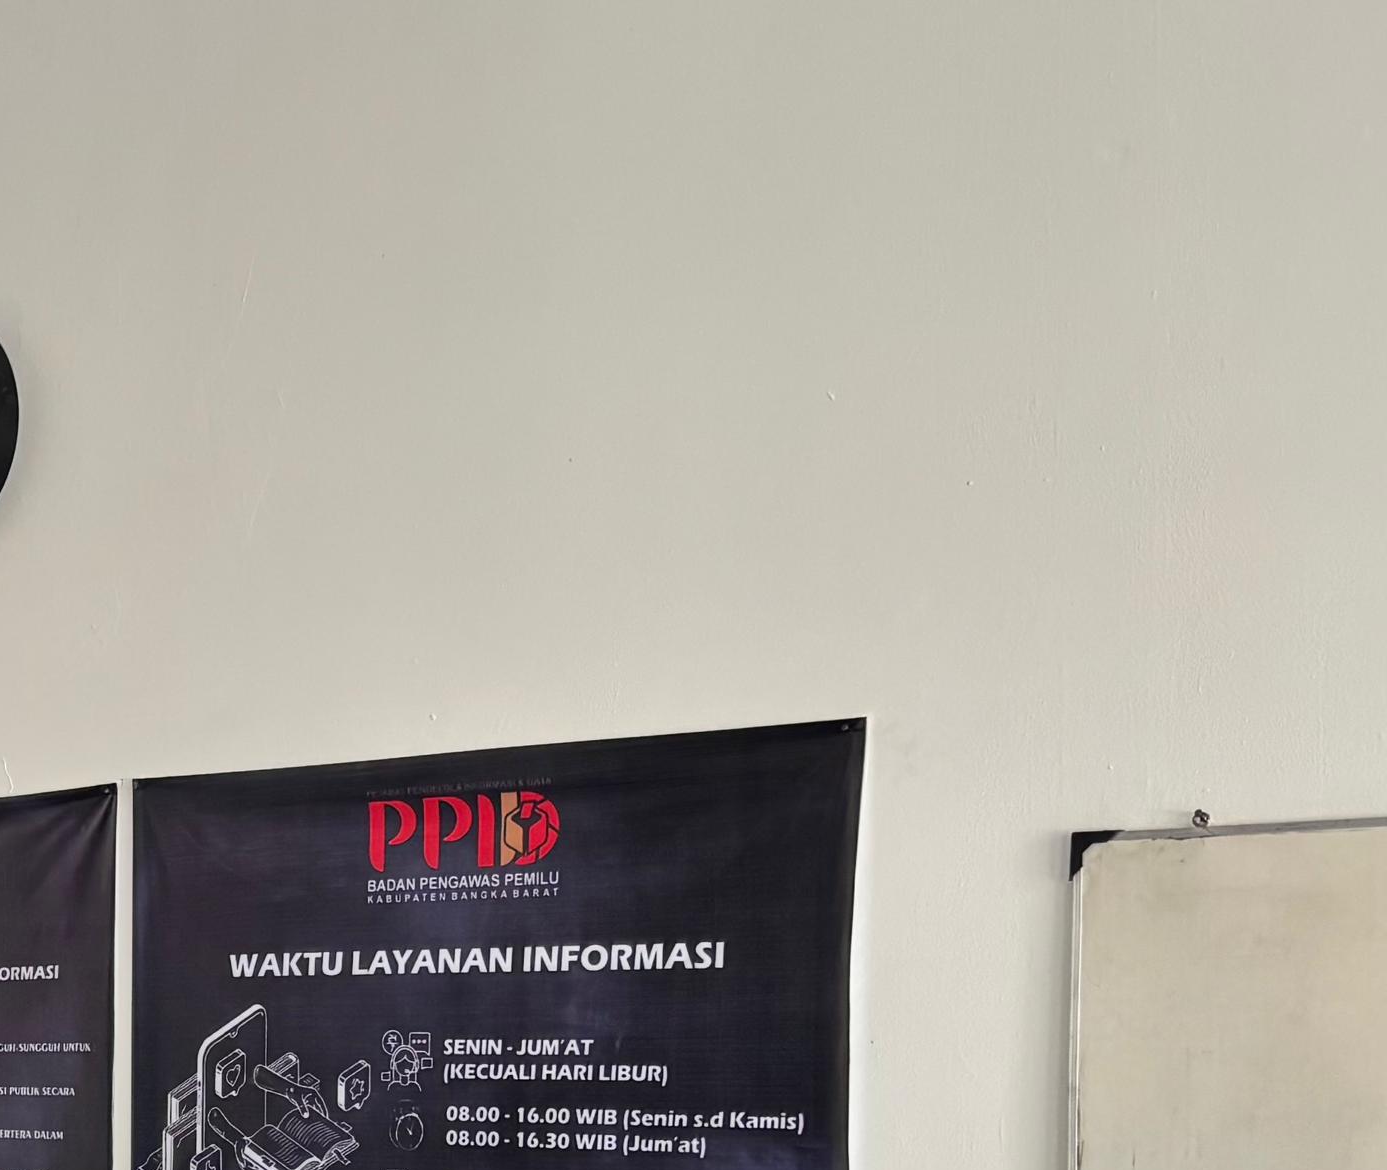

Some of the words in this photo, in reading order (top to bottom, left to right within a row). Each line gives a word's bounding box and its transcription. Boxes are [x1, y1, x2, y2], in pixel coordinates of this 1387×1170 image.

[368, 791, 560, 872] PPID
[367, 877, 415, 892] BADAN
[419, 873, 499, 889] PENGAWAS
[504, 871, 559, 887] PEMILU
[229, 951, 343, 977] WAKTU
[351, 947, 512, 974] LAYANAN
[523, 941, 724, 971] INFORMASI
[443, 1038, 502, 1054] SENIN
[516, 1039, 593, 1055] JUM'AT
[443, 1063, 536, 1083] (KECUALI
[541, 1064, 593, 1080] HARI
[598, 1064, 667, 1086] LIBUR)
[446, 1105, 499, 1122] 08.00
[517, 1107, 570, 1123] 16.00
[575, 1108, 617, 1124] WIB
[623, 1109, 687, 1130] (Senin
[693, 1111, 723, 1127] s.d
[729, 1111, 803, 1134] Kamis)
[445, 1129, 499, 1146] 08.00
[517, 1131, 569, 1149] 16.30
[575, 1133, 616, 1150] WIB
